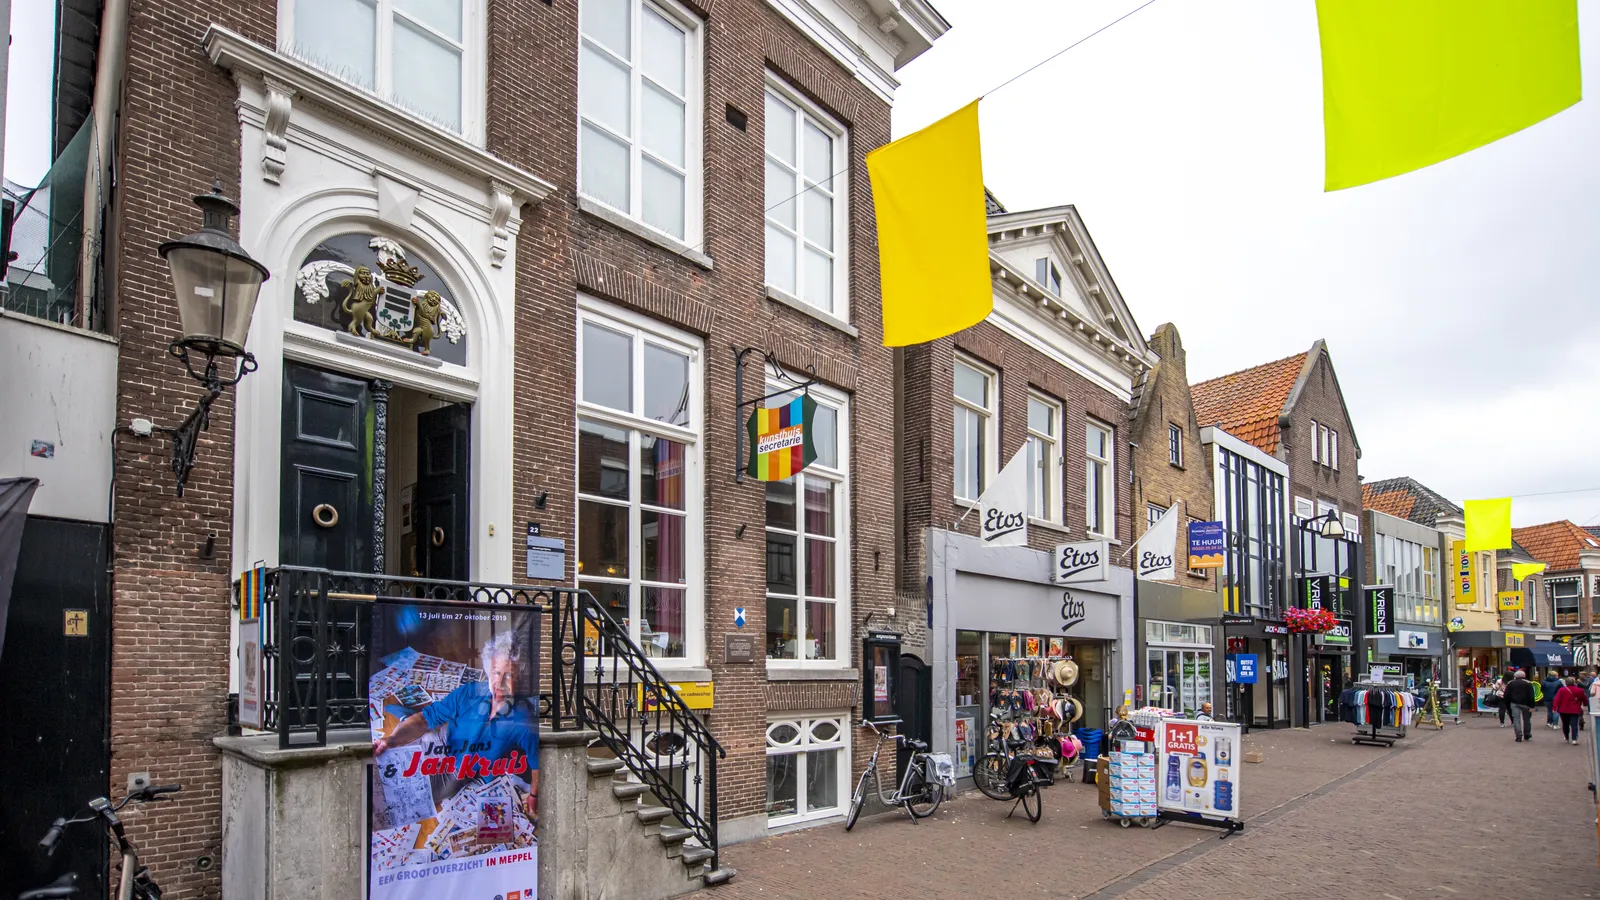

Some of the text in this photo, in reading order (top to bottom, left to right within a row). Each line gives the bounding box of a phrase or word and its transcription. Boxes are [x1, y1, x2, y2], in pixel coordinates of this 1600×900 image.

[759, 435, 801, 453] secretarie
[760, 427, 800, 444] kunsthuis
[984, 508, 1024, 532] Etos
[1060, 547, 1099, 569] Etos
[1140, 551, 1173, 569] Etos
[1061, 592, 1085, 620] Etos
[1376, 590, 1386, 633] VRIEND
[464, 613, 491, 621] oktober
[1169, 729, 1193, 743] 1+1
[459, 740, 491, 754] Jans
[1168, 741, 1196, 751] GRATIS
[384, 750, 528, 781] & Jan Kruis
[378, 852, 533, 886] EEN GROOT OVERZICHT IN MEPPEL
